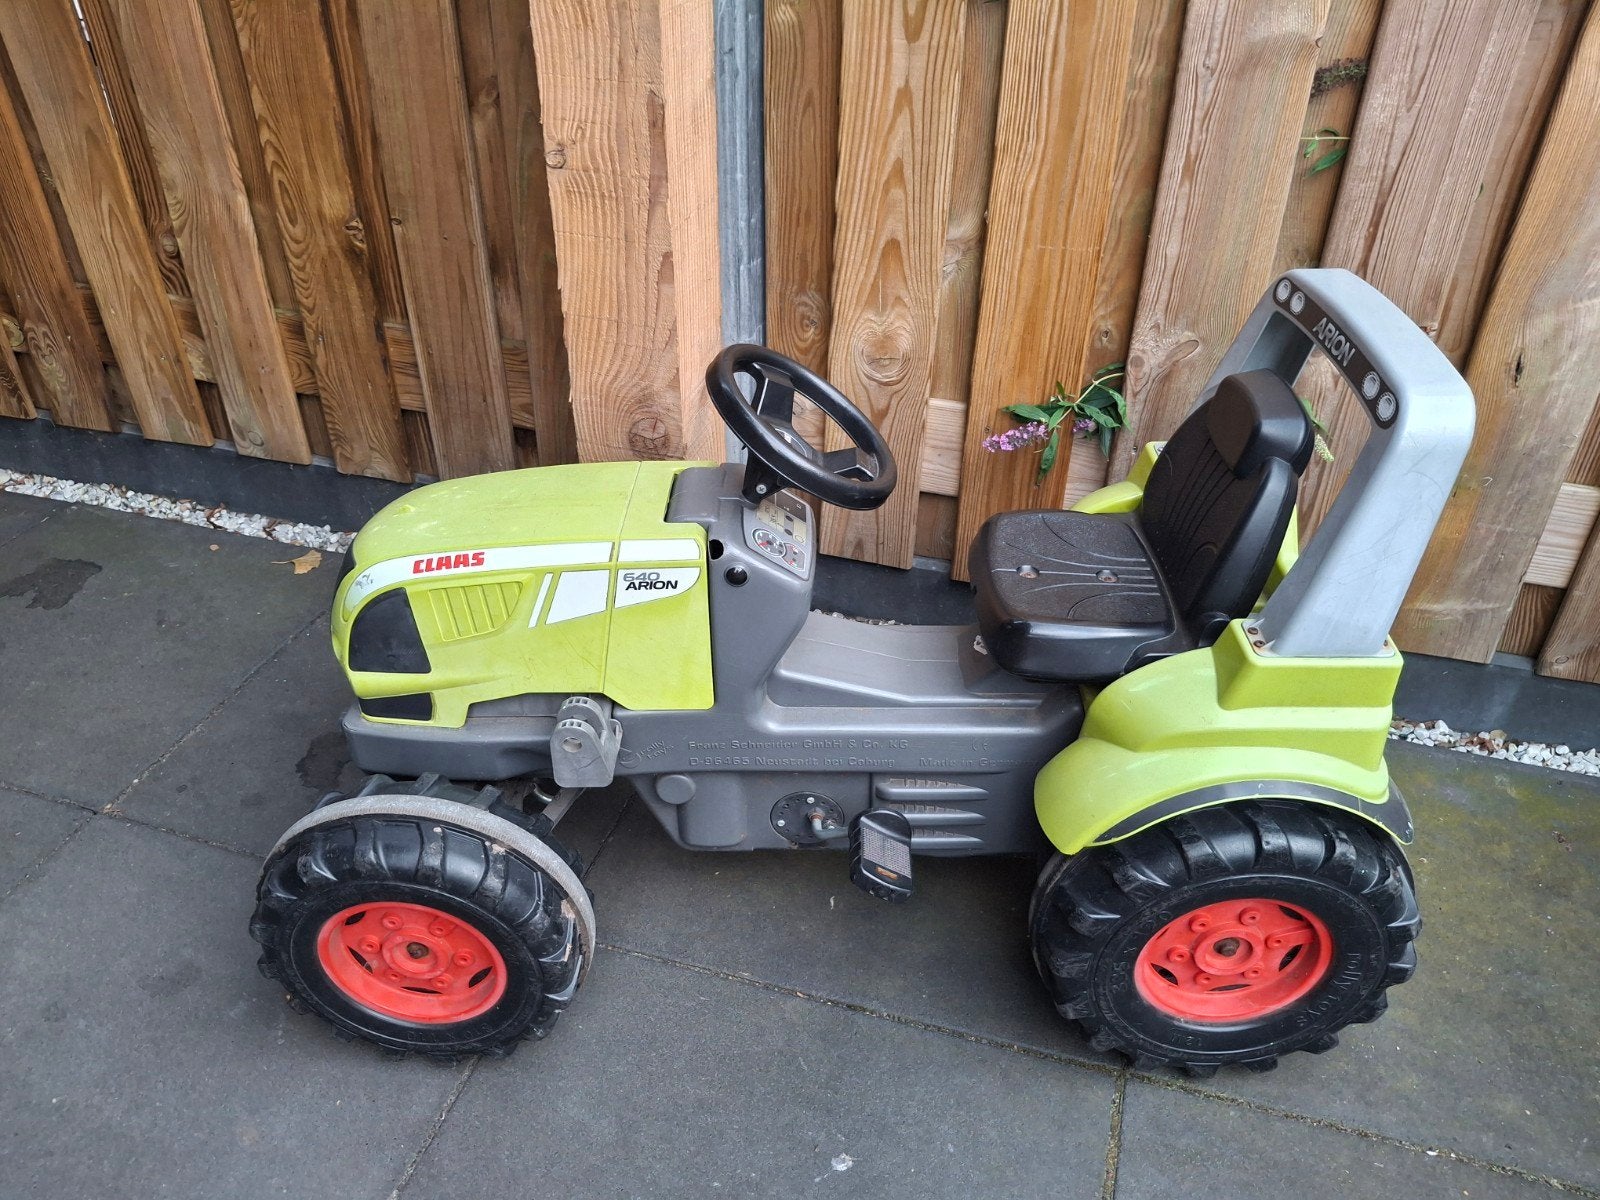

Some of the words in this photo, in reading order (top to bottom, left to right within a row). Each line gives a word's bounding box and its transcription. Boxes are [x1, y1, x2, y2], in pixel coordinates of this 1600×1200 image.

[1312, 317, 1355, 367] ARION
[412, 551, 485, 574] CLAAS
[622, 571, 660, 582] 640
[624, 579, 679, 591] ARION
[688, 739, 726, 749] Franz
[731, 739, 797, 749] Schneider
[802, 738, 842, 749] GmbH
[888, 739, 910, 750] KG
[754, 756, 819, 766] Neustadt
[847, 756, 896, 768] Coburg
[919, 757, 956, 767] Made
[961, 757, 974, 767] in
